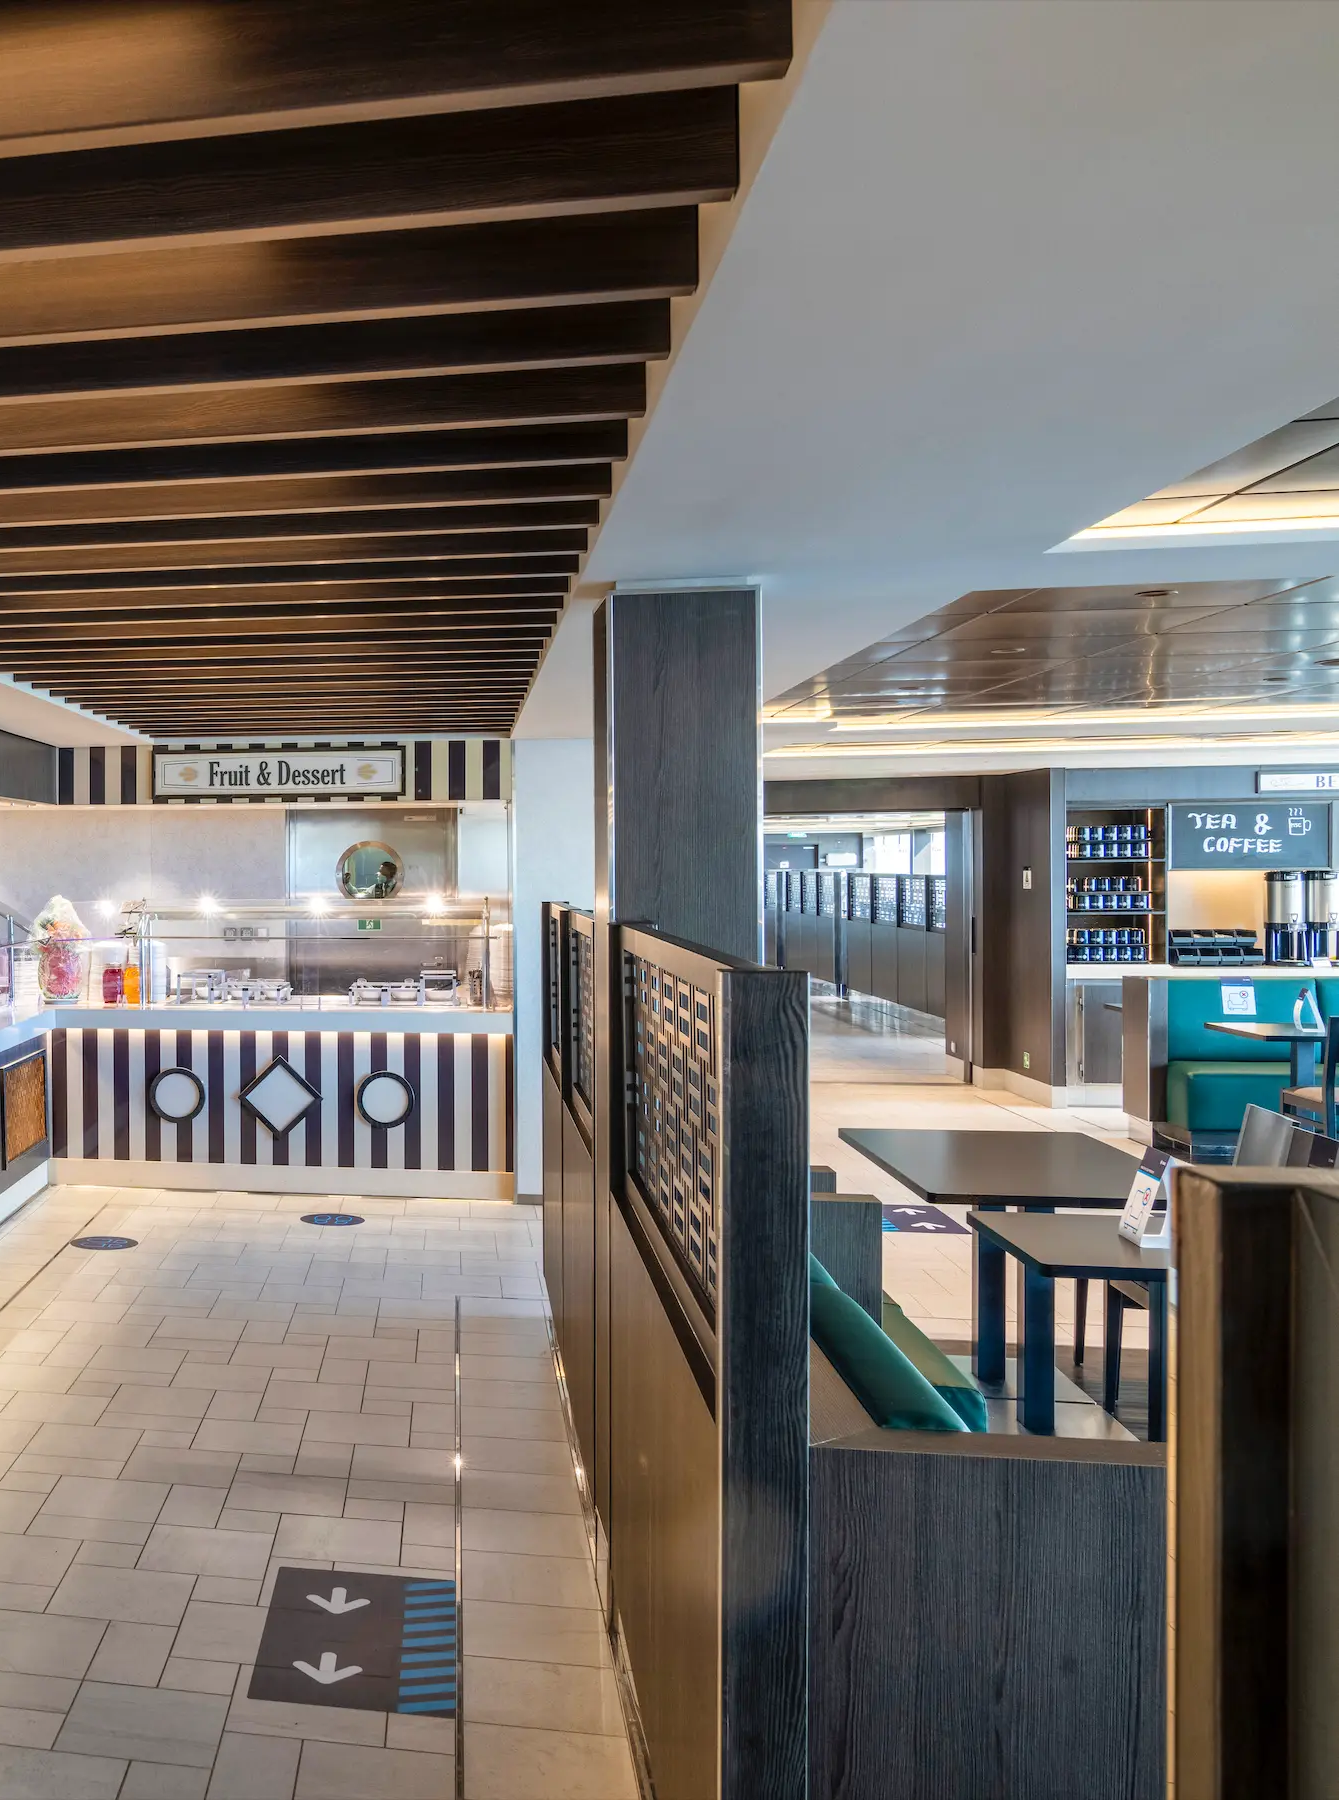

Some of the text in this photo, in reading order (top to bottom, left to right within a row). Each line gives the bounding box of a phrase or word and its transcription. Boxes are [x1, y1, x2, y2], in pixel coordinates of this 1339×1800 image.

[208, 760, 346, 786] Fruit & Dessert
[1187, 812, 1273, 836] TEA &
[1203, 836, 1283, 853] COFFEE
